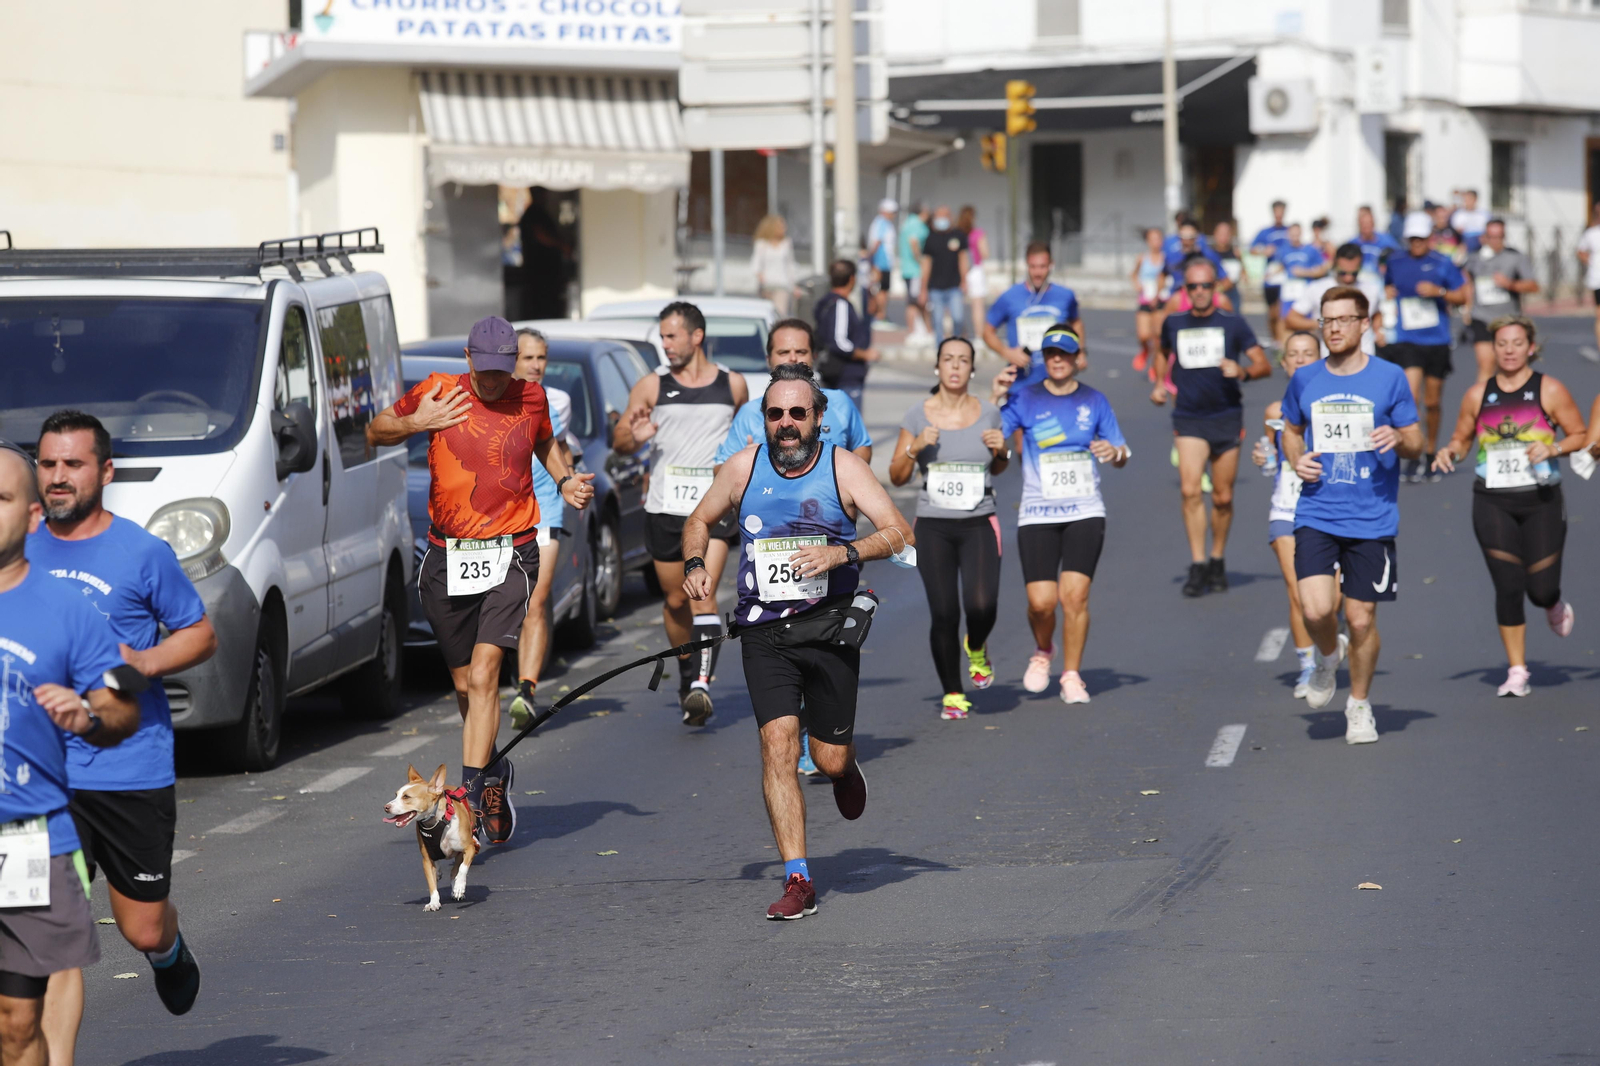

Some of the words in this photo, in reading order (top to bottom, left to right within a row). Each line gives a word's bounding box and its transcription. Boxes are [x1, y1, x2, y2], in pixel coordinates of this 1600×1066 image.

[397, 18, 546, 39] PATATAS
[558, 22, 672, 43] FRITAS
[500, 407, 530, 427] TRAIL
[1324, 423, 1350, 439] 341
[1497, 458, 1520, 474] 282
[1051, 470, 1077, 486] 288
[673, 485, 698, 500] 172
[937, 481, 964, 496] 489
[460, 541, 480, 550] VUELTA
[480, 541, 486, 549] A
[768, 541, 790, 551] VUELTA
[791, 541, 797, 550] A
[460, 560, 491, 579] 235
[67, 570, 77, 579] A
[77, 571, 113, 595] HUELVA
